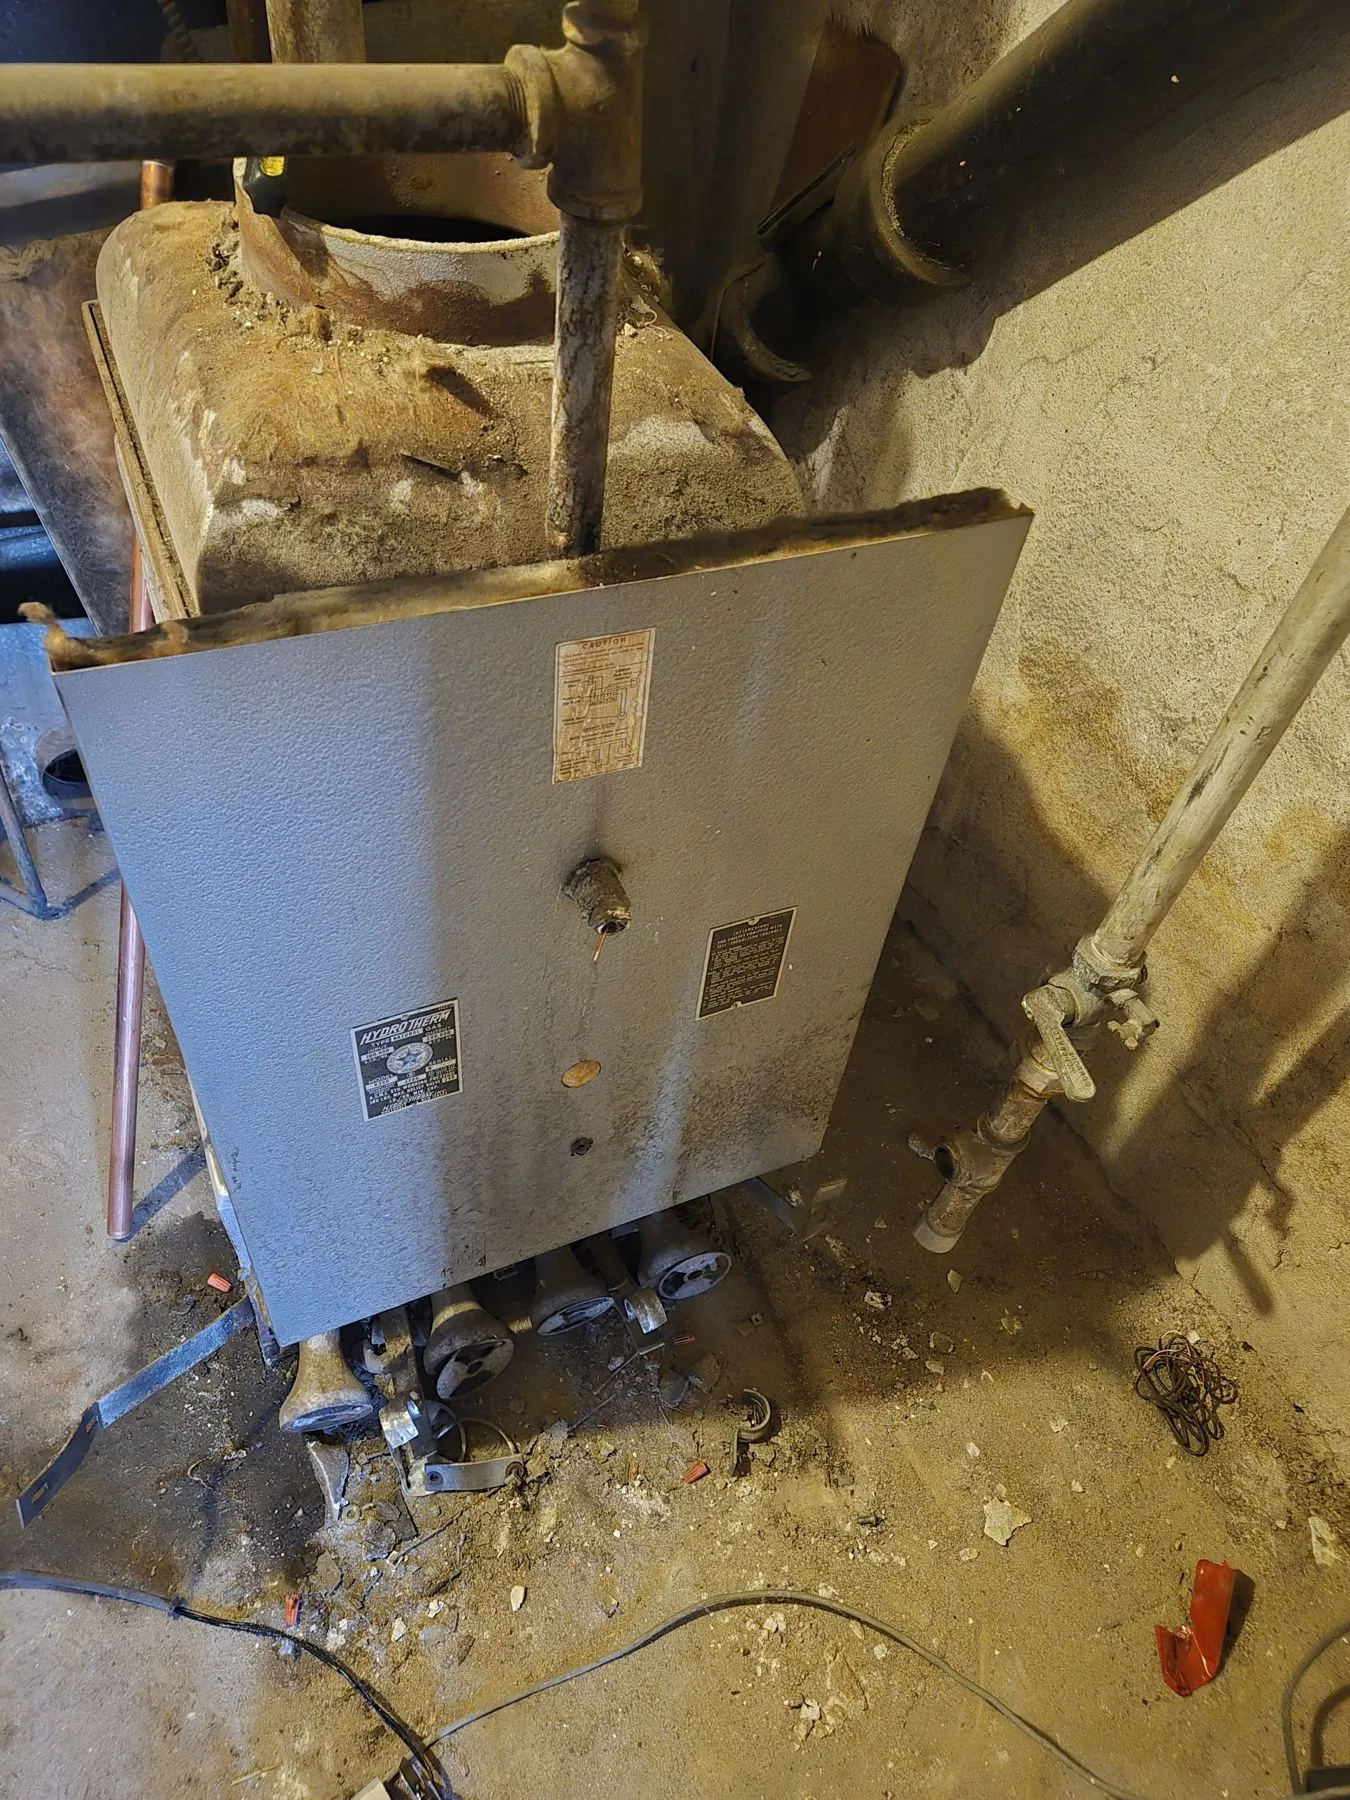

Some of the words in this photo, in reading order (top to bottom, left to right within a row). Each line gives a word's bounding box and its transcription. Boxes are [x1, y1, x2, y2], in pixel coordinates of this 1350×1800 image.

[582, 637, 626, 650] CAUTION
[359, 1009, 452, 1046] HYDROTHERM
[371, 1039, 390, 1048] TYPE
[393, 1030, 420, 1041] NATURAL
[425, 1023, 442, 1032] GAS
[367, 1044, 387, 1053] INPUT
[368, 1073, 394, 1084] MODEL
